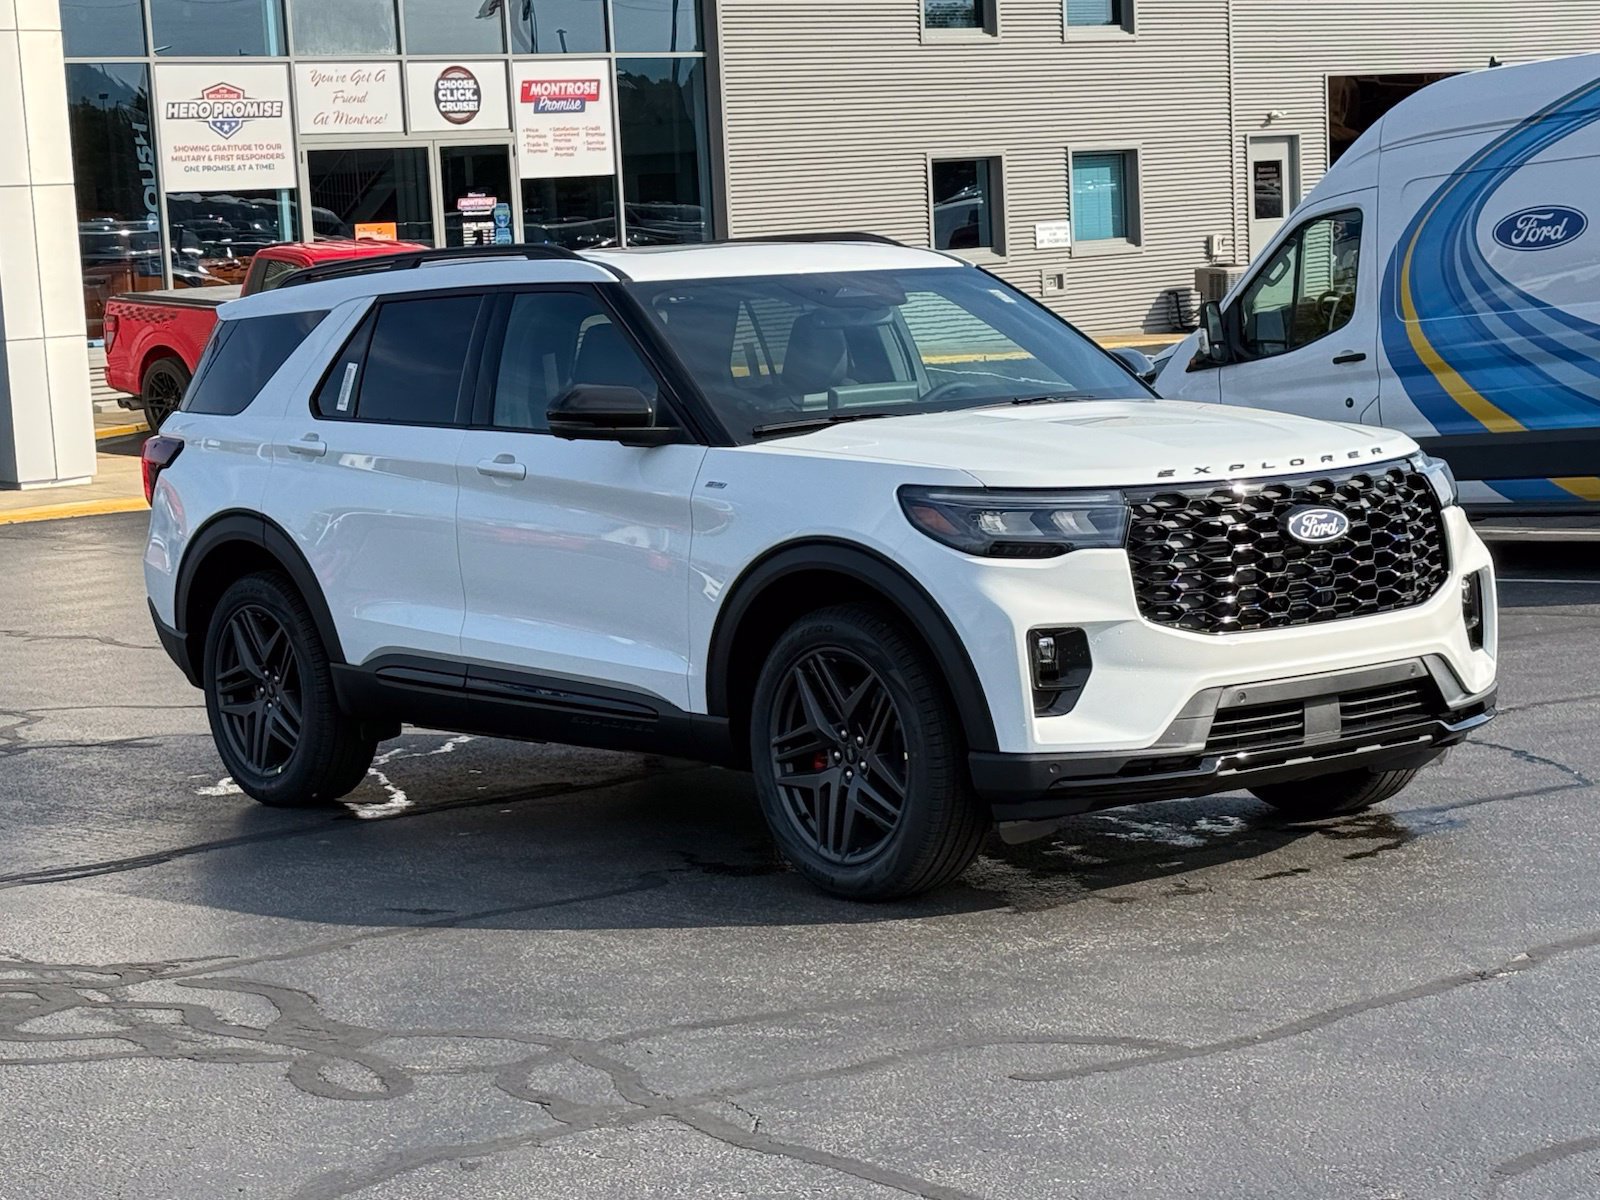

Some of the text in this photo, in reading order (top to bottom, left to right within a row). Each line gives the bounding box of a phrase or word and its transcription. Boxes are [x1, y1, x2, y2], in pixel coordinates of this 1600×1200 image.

[310, 69, 386, 87] You've Got A
[438, 79, 477, 89] CHOOSE.
[438, 89, 477, 101] CLICK.
[529, 81, 598, 96] MONTROSE
[332, 90, 369, 104] Friend
[538, 96, 582, 111] Promise
[166, 101, 283, 119] HERO PROMISE
[439, 101, 478, 112] CRUISE!
[313, 110, 388, 125] At Montrose!
[171, 154, 206, 162] MILITARY
[202, 164, 236, 172] PROMISE
[1511, 212, 1569, 244] Ford
[1157, 447, 1383, 478] EXPLORER
[1299, 512, 1340, 538] Ford
